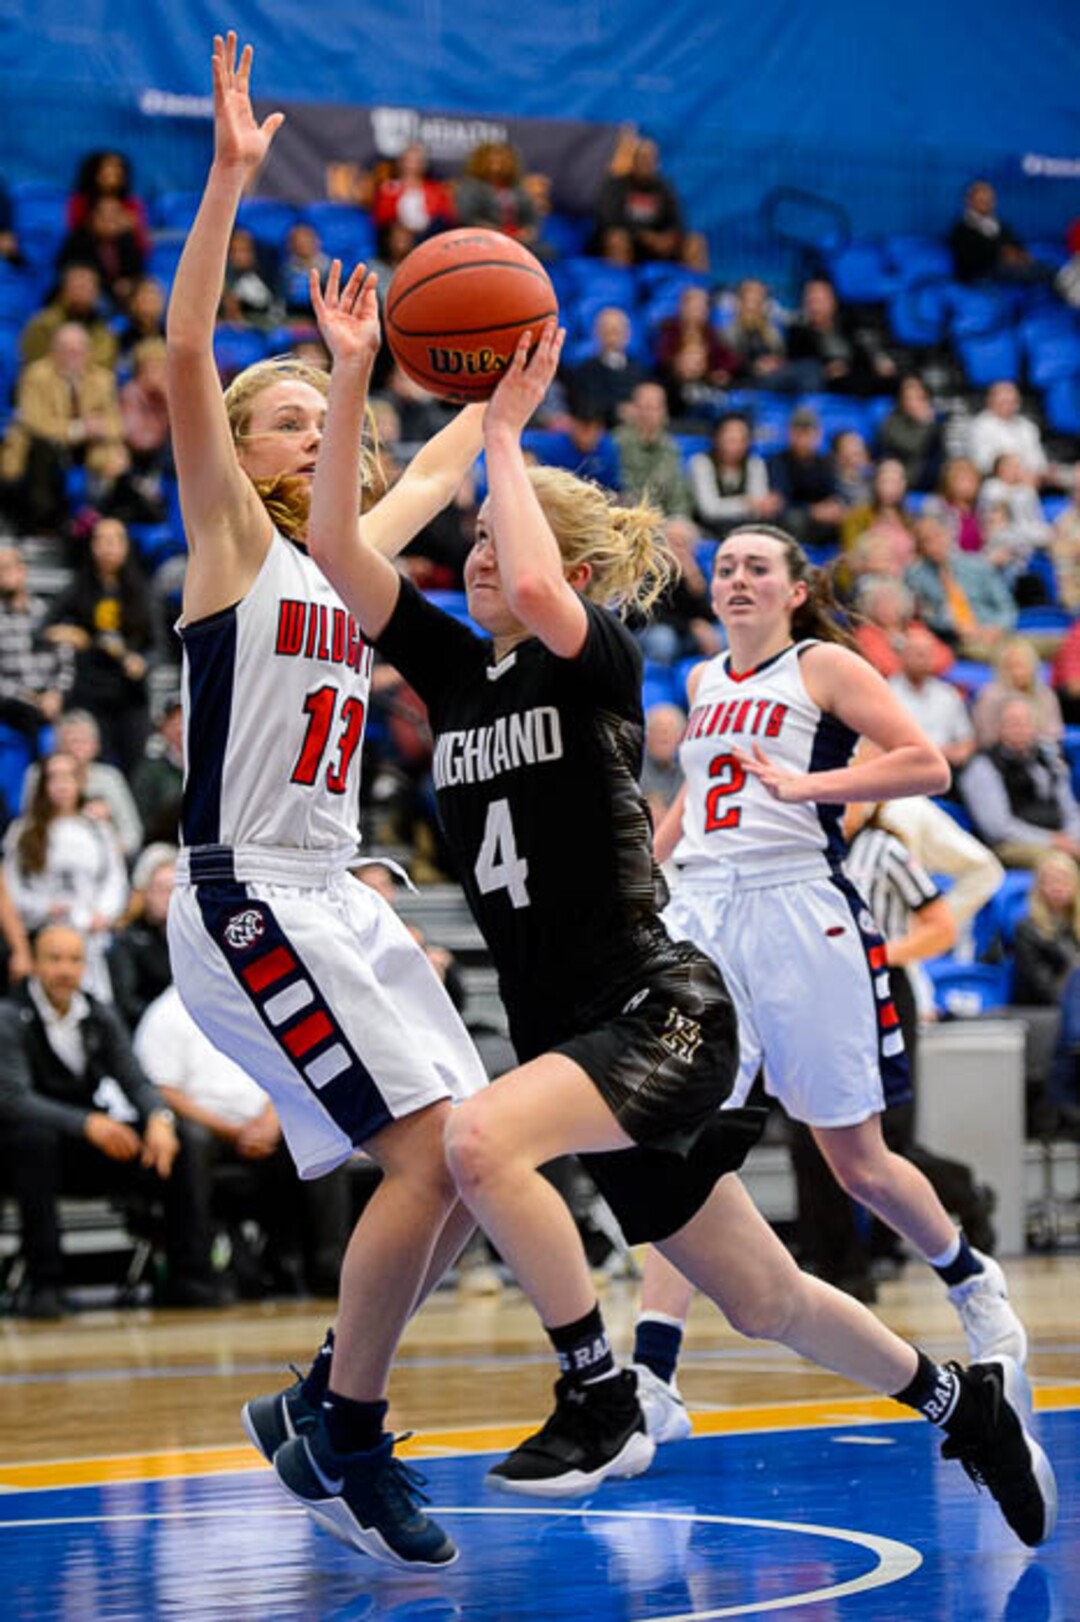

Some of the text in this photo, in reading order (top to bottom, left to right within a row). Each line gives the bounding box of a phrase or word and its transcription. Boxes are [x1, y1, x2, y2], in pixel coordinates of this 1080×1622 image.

[427, 347, 512, 375] Wils
[275, 598, 370, 679] WILDC
[290, 684, 365, 795] 13
[704, 753, 747, 834] 2
[473, 797, 531, 909] 4
